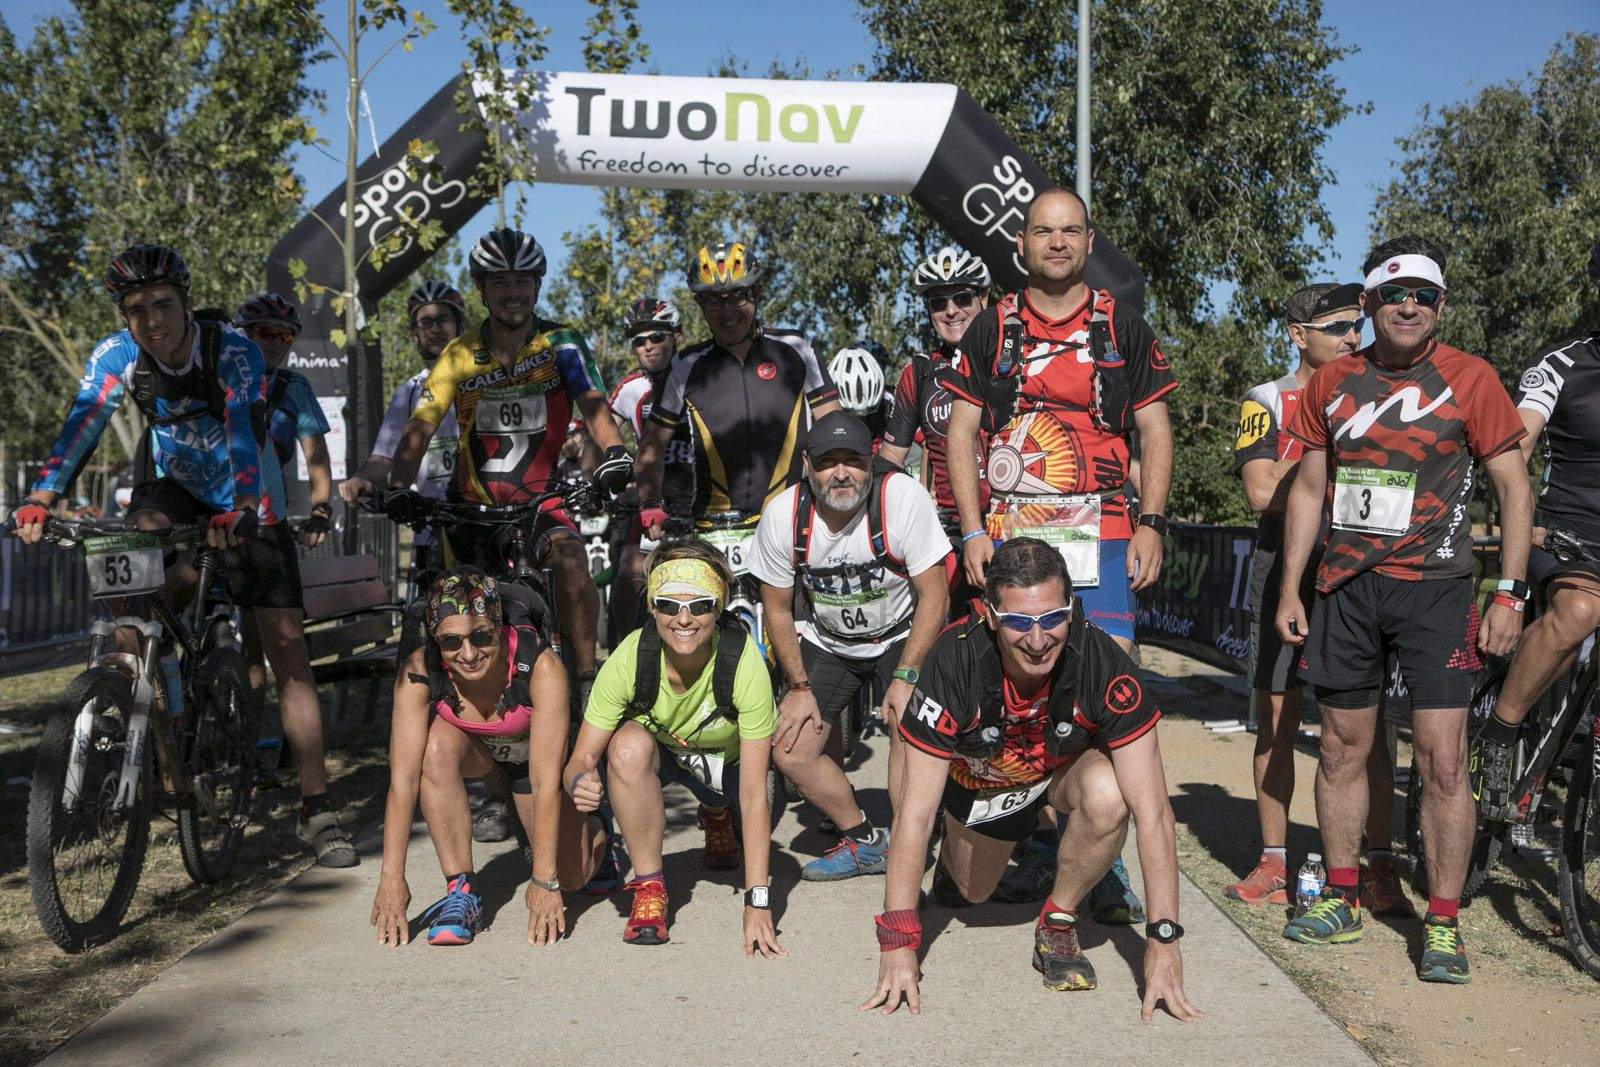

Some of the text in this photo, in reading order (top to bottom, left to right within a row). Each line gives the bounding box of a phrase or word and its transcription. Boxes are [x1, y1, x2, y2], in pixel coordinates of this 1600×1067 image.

[565, 86, 865, 143] TwoNav
[577, 150, 851, 178] freedom to discover
[458, 369, 506, 394] SCALE
[500, 402, 523, 427] 69
[1359, 488, 1372, 520] 3
[104, 554, 133, 587] 53
[840, 607, 868, 630] 64
[1002, 789, 1031, 810] 63
